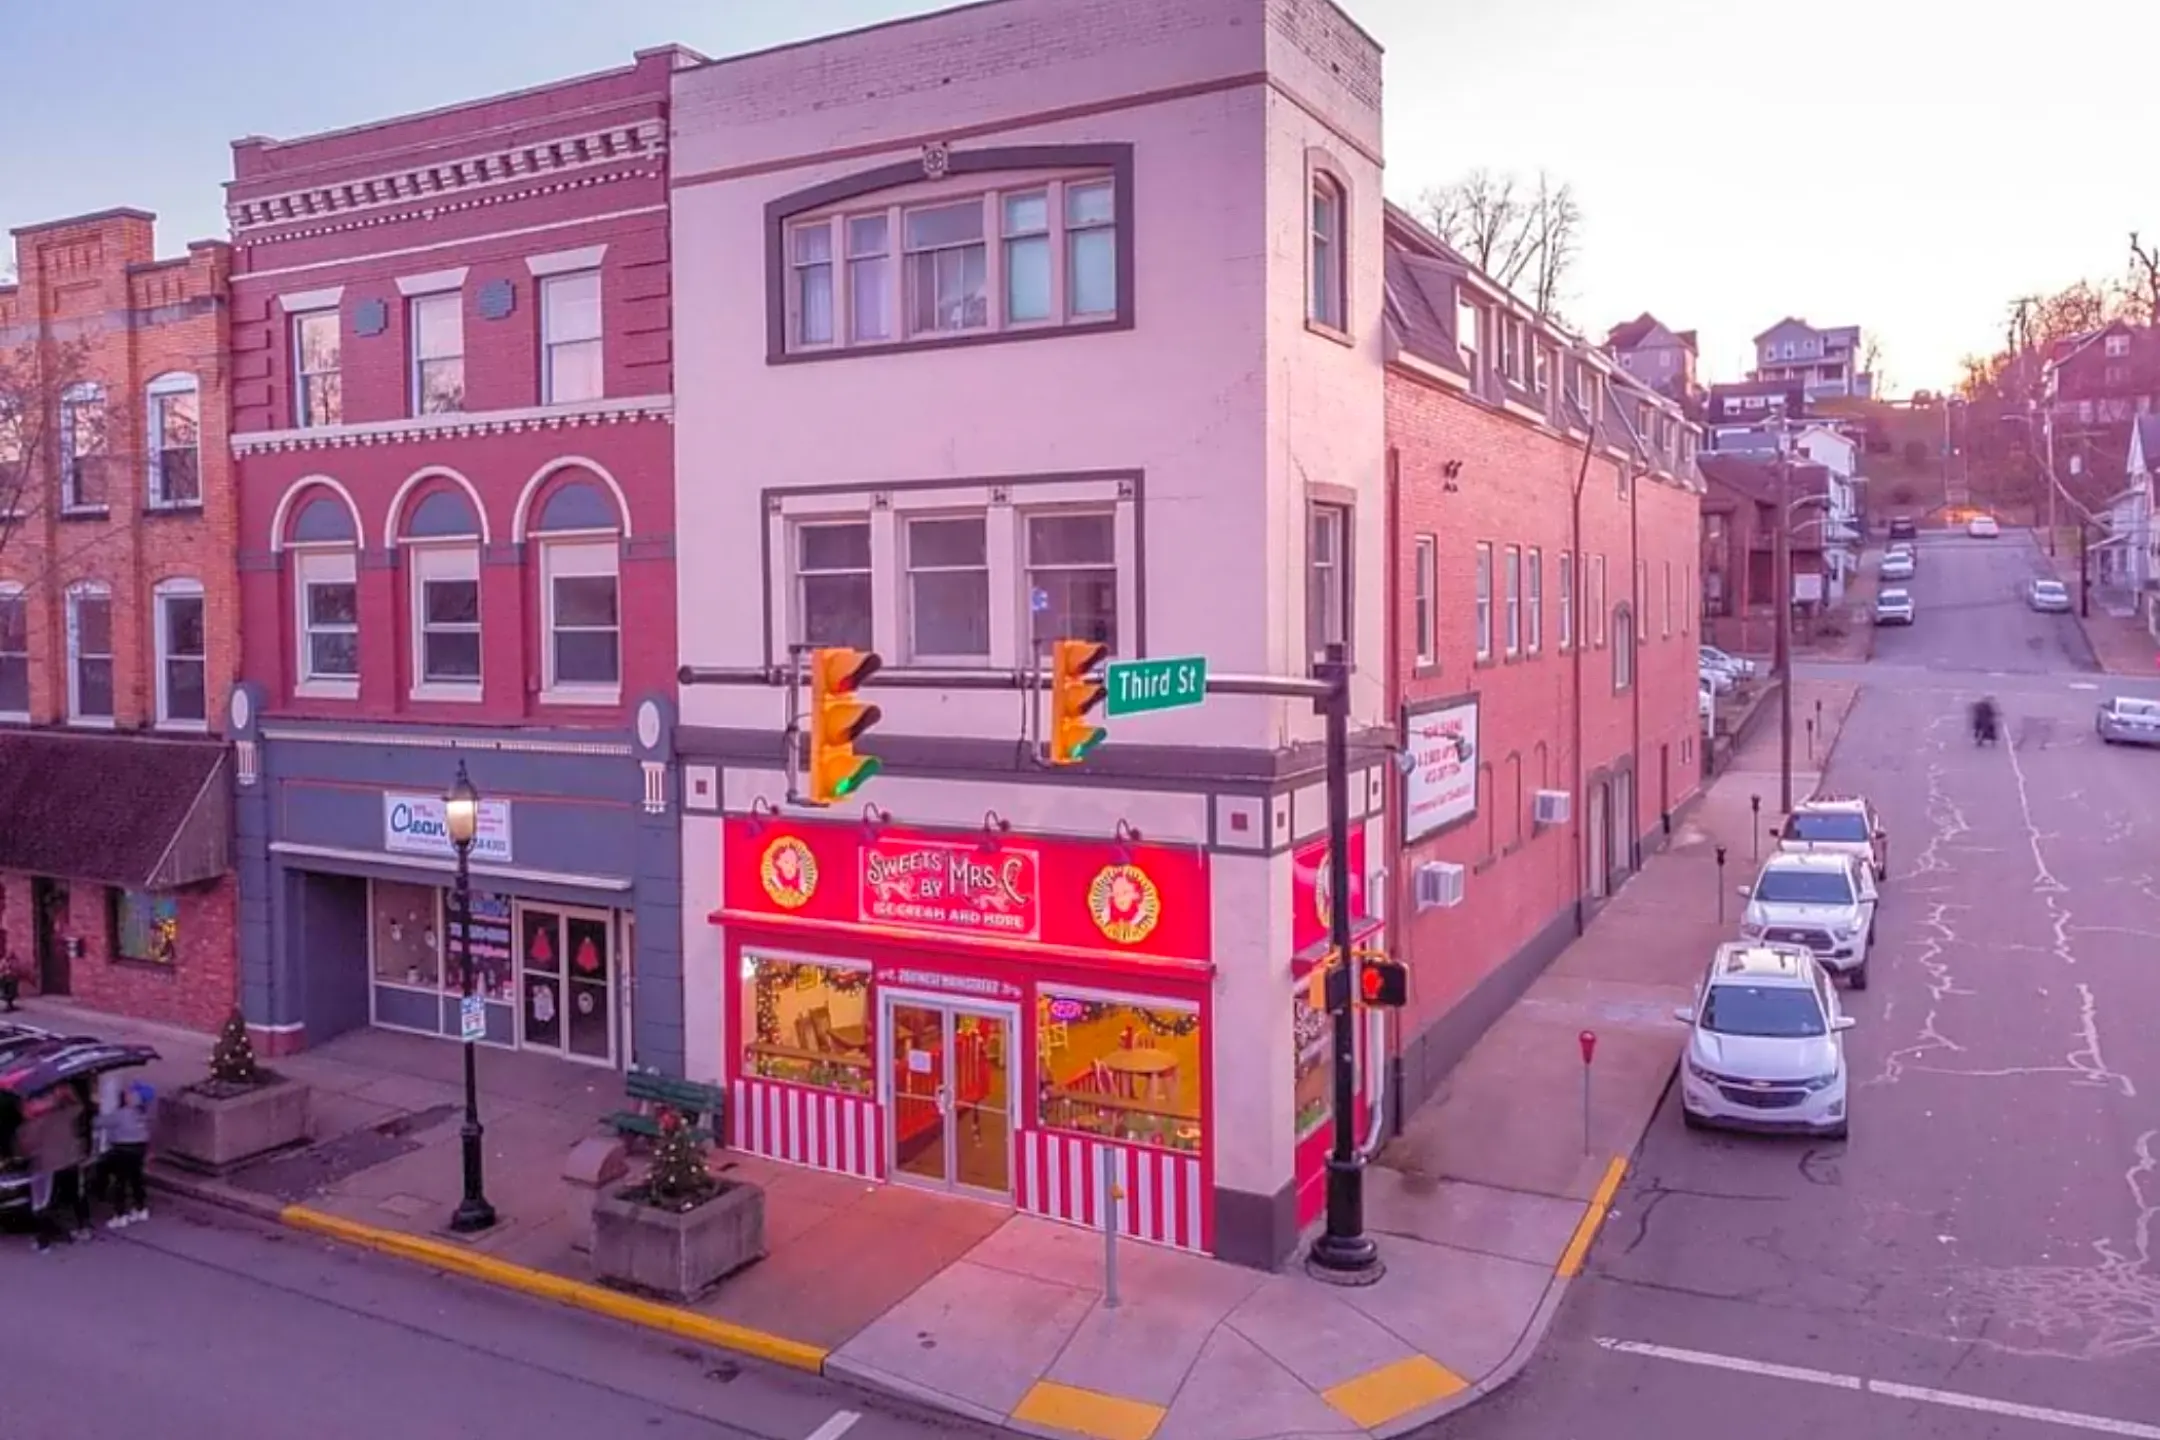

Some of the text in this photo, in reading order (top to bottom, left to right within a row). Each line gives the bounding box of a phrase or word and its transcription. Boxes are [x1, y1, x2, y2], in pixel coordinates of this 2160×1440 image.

[1118, 665, 1196, 702] Third St
[867, 850, 943, 885] SWEETS
[920, 878, 942, 898] BY
[896, 902, 946, 922] CREAM
[949, 908, 981, 925] AND
[983, 912, 1025, 931] MORE
